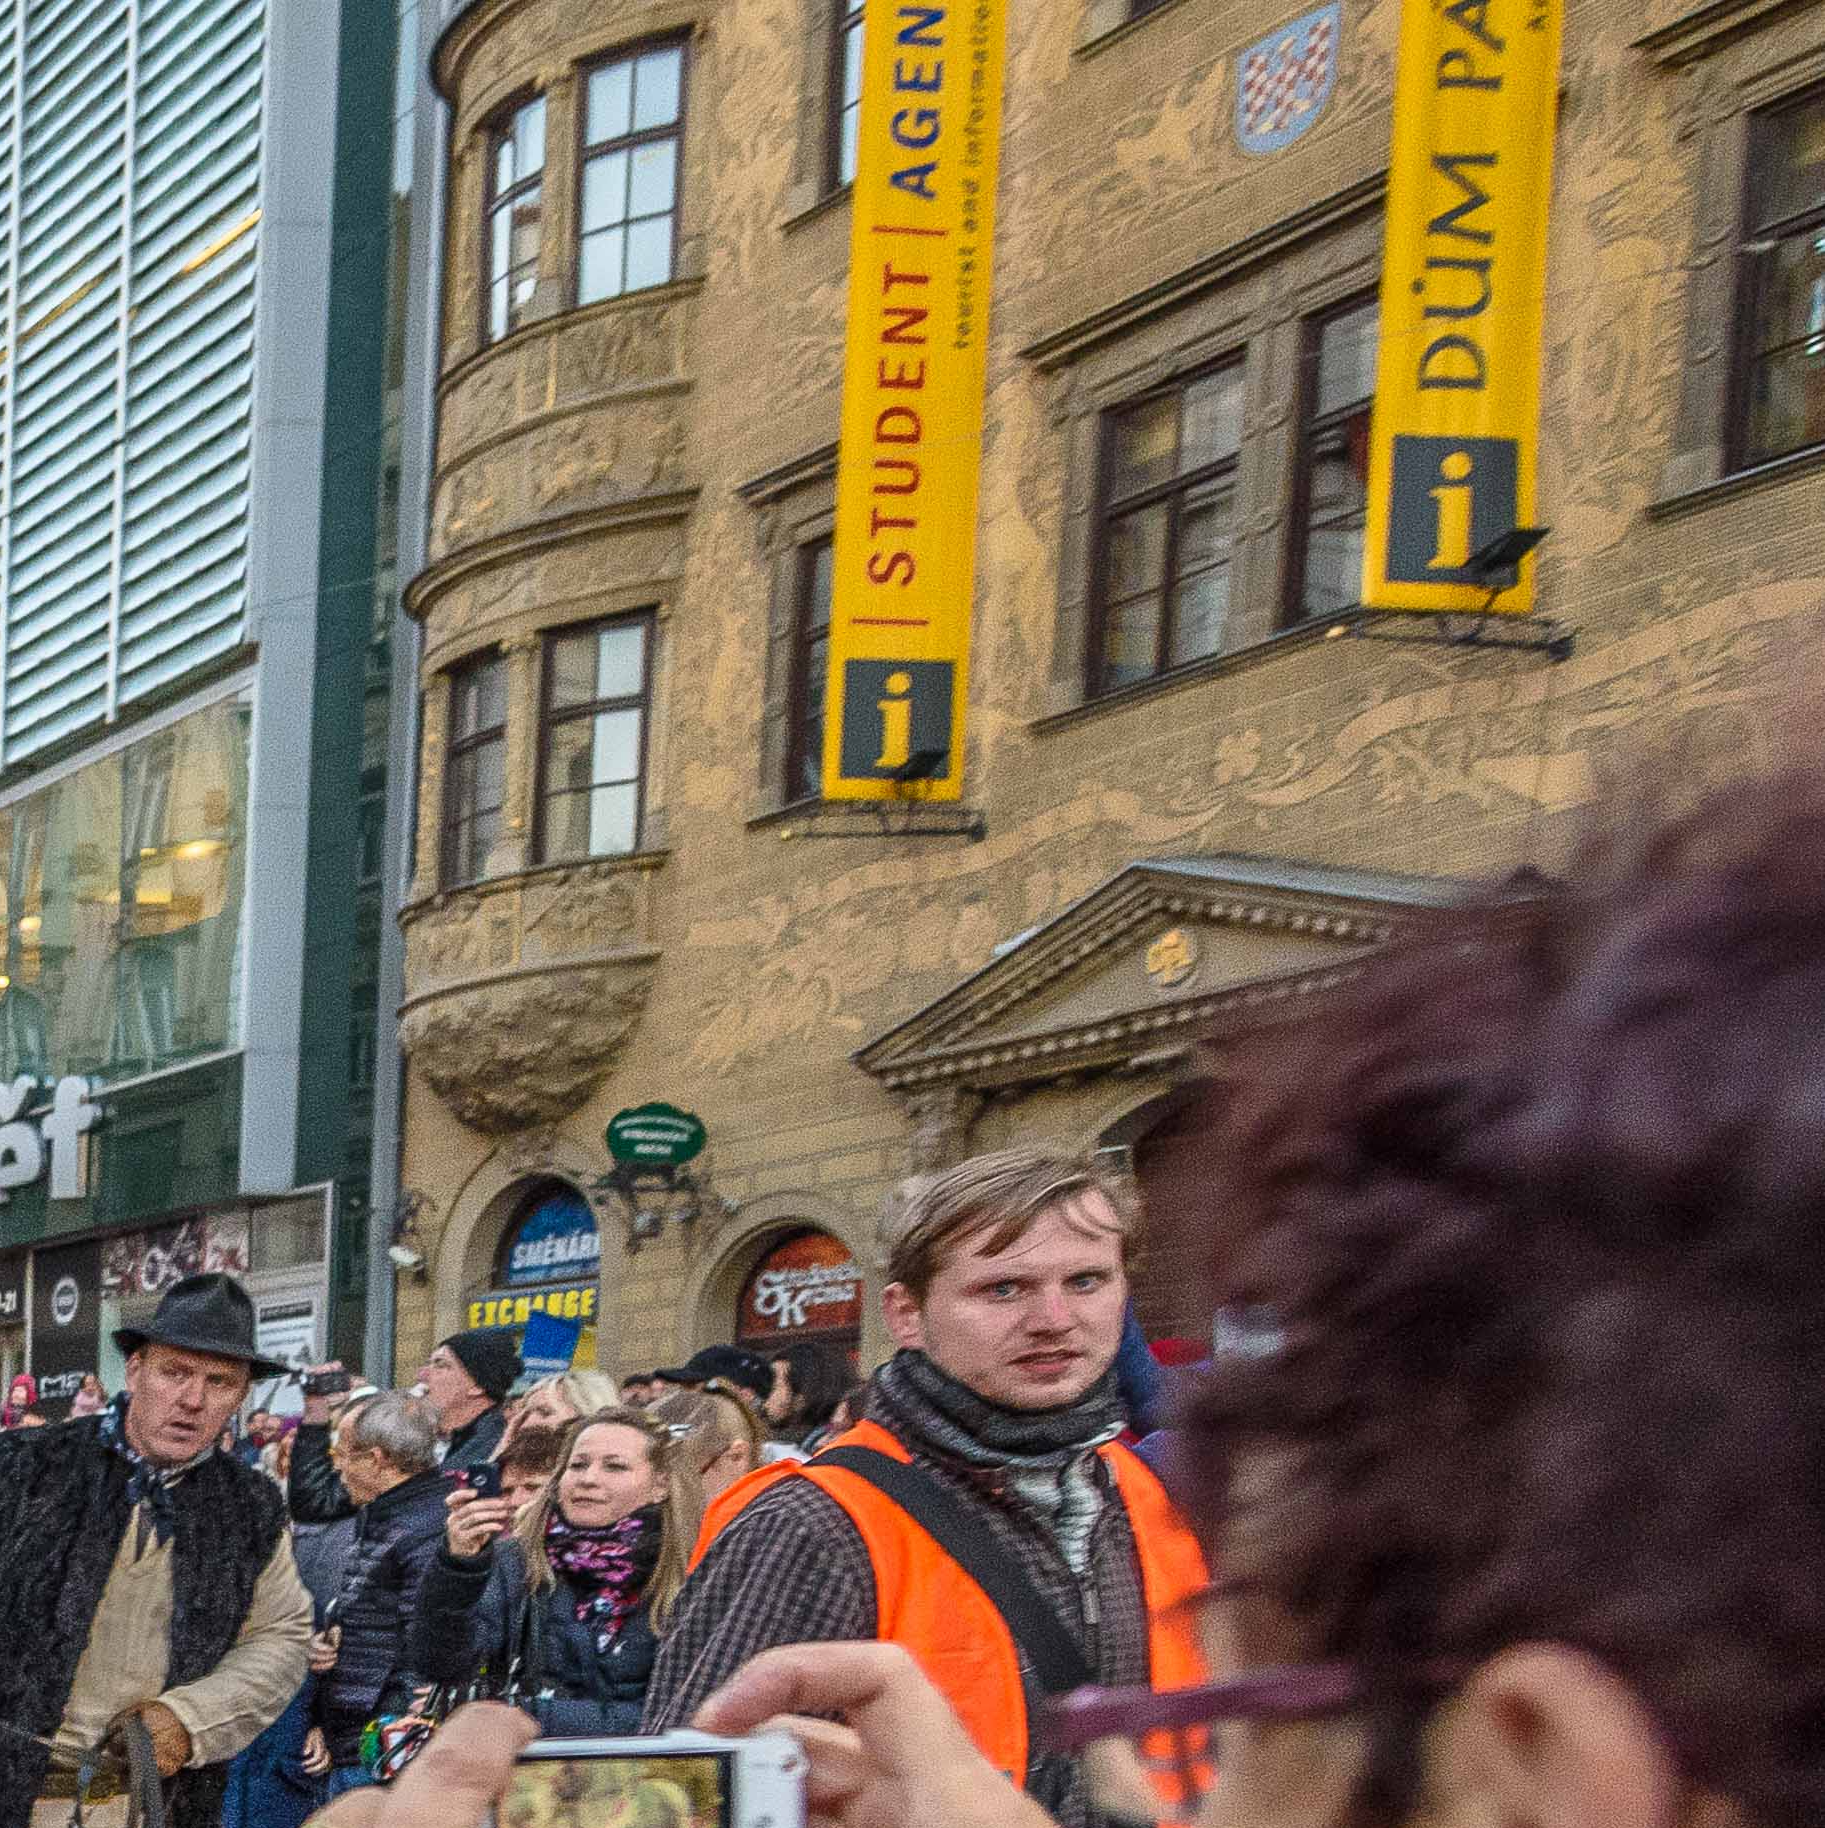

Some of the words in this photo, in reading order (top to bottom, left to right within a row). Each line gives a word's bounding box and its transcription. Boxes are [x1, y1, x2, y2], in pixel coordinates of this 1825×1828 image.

[889, 1, 946, 201] AGEN
[961, 0, 992, 168] informatio
[961, 177, 981, 234] and
[954, 246, 978, 350] tourist
[865, 259, 930, 587] STUDENT
[468, 1287, 597, 1329] EXCHANGE
